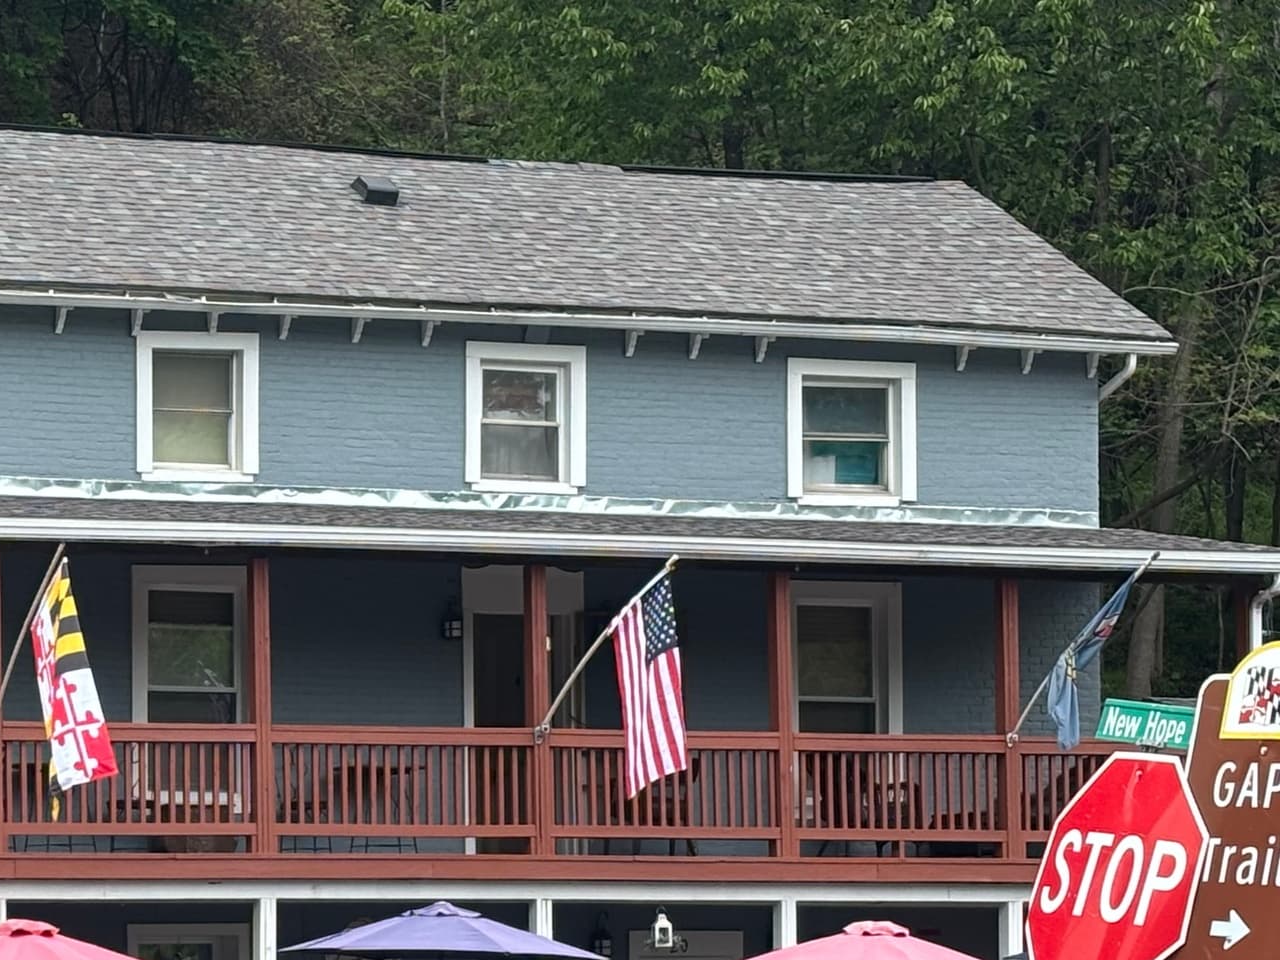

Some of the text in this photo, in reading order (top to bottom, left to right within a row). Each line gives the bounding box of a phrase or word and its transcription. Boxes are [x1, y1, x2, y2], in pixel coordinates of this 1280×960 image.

[1102, 706, 1187, 745] New Hope
[1213, 761, 1280, 808] GAP
[1040, 828, 1188, 927] STOP
